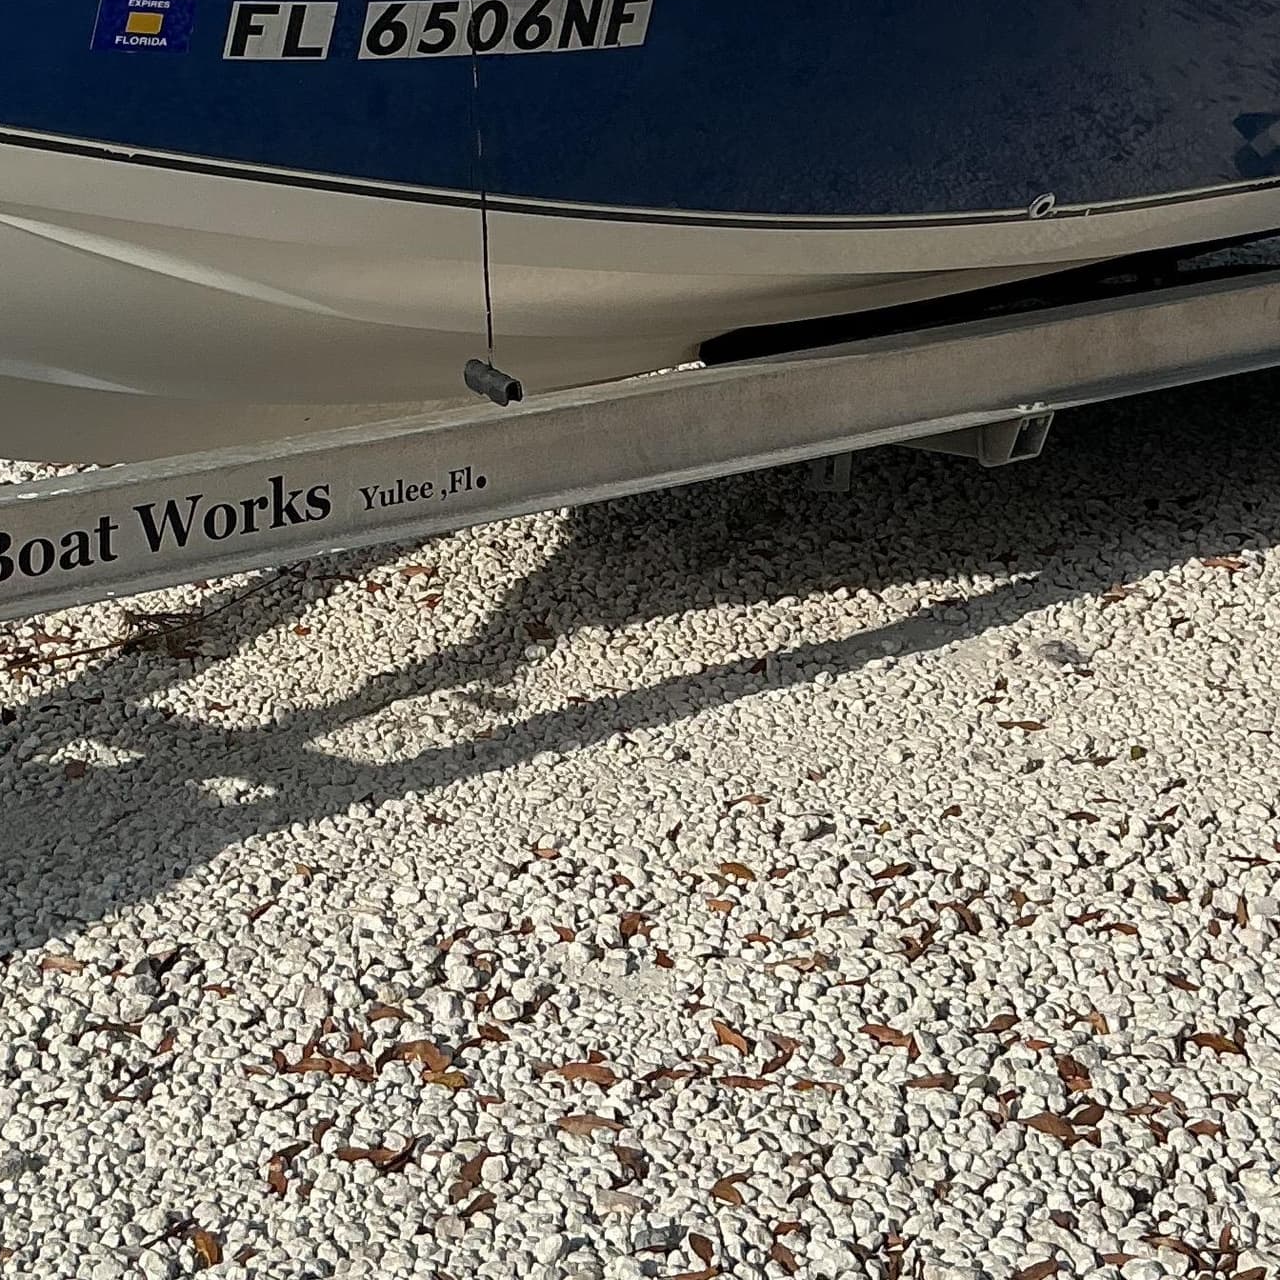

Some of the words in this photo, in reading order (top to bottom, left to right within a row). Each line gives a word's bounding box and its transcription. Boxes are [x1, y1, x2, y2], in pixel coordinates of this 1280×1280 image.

[128, 0, 171, 9] EXPIRES
[115, 35, 168, 47] FLORIDA
[229, 3, 325, 58] FL
[134, 476, 332, 553] Works
[359, 479, 434, 511] Yulee
